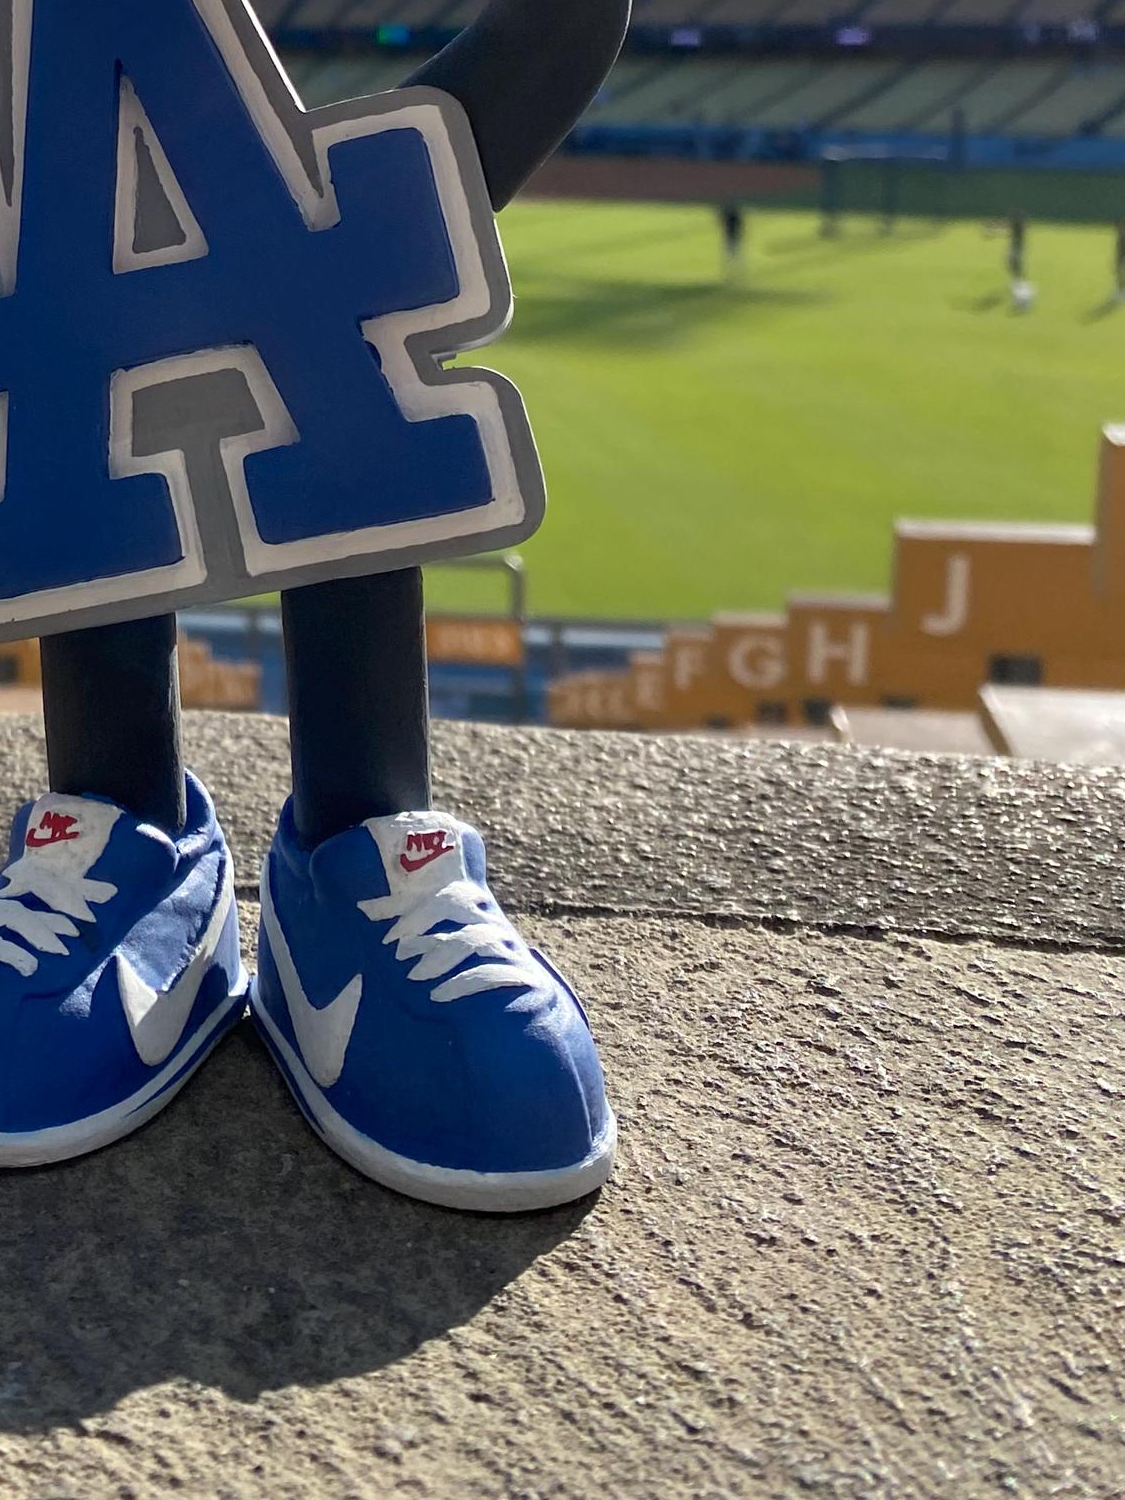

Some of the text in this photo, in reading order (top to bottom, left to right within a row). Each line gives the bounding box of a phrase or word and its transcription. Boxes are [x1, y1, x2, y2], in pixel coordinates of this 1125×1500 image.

[920, 553, 971, 636] J
[728, 634, 788, 688] G
[805, 619, 871, 687] H
